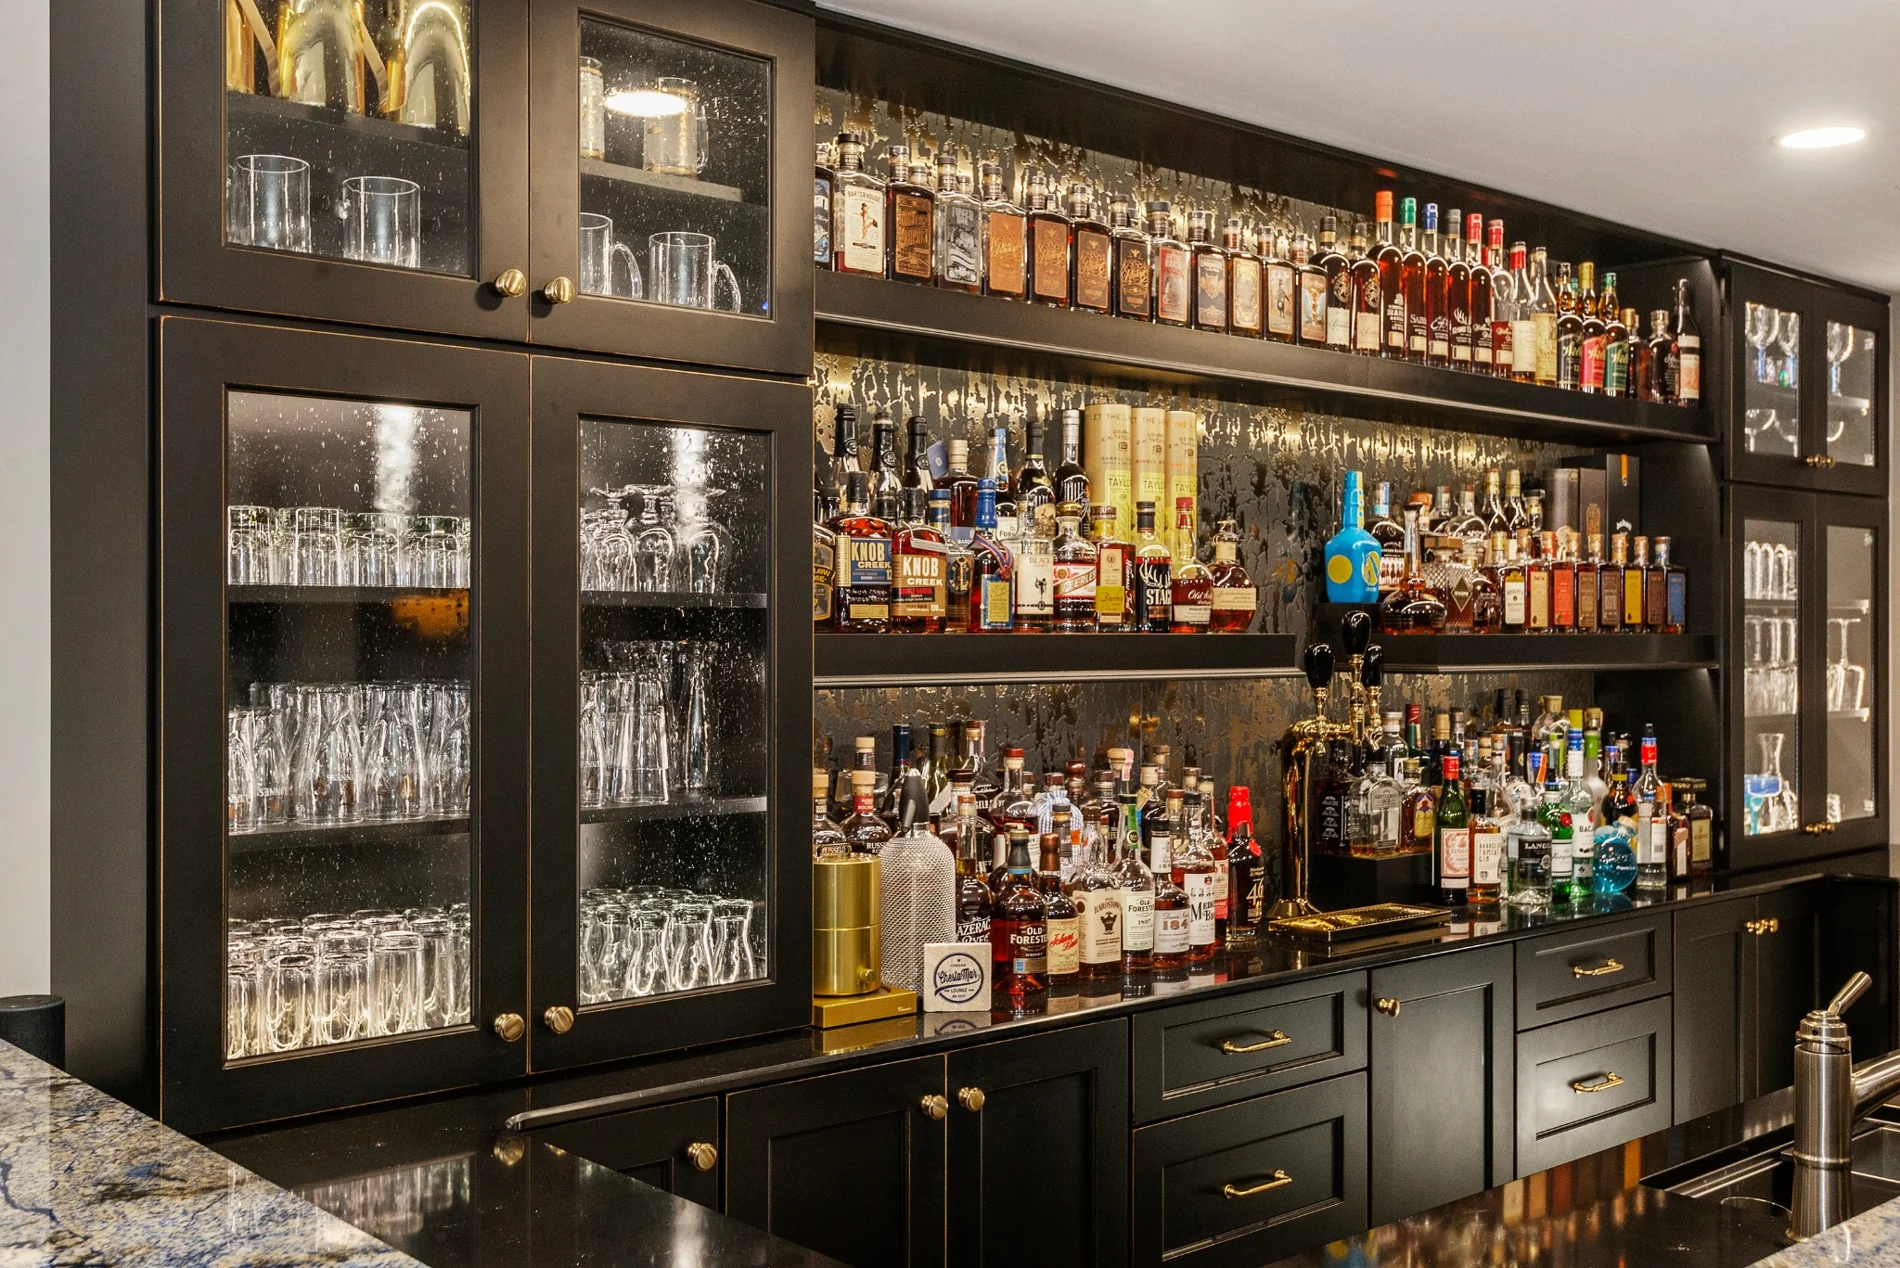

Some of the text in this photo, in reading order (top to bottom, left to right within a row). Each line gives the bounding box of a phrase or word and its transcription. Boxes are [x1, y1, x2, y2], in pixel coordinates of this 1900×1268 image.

[1108, 478, 1131, 487] TAYLO
[1143, 480, 1165, 489] TAYLO
[1175, 483, 1197, 493] TAYLO
[851, 542, 885, 561] KNOB
[857, 561, 891, 569] CREEK
[903, 556, 939, 577] KNOB
[906, 577, 943, 586] CREEK
[1146, 588, 1172, 605] STAG
[1579, 825, 1595, 833] BACA
[1246, 877, 1264, 906] 46
[956, 918, 991, 936] AZERAC
[1162, 919, 1188, 931] 184
[1026, 926, 1043, 935] OLD
[1010, 933, 1047, 944] FORESTE
